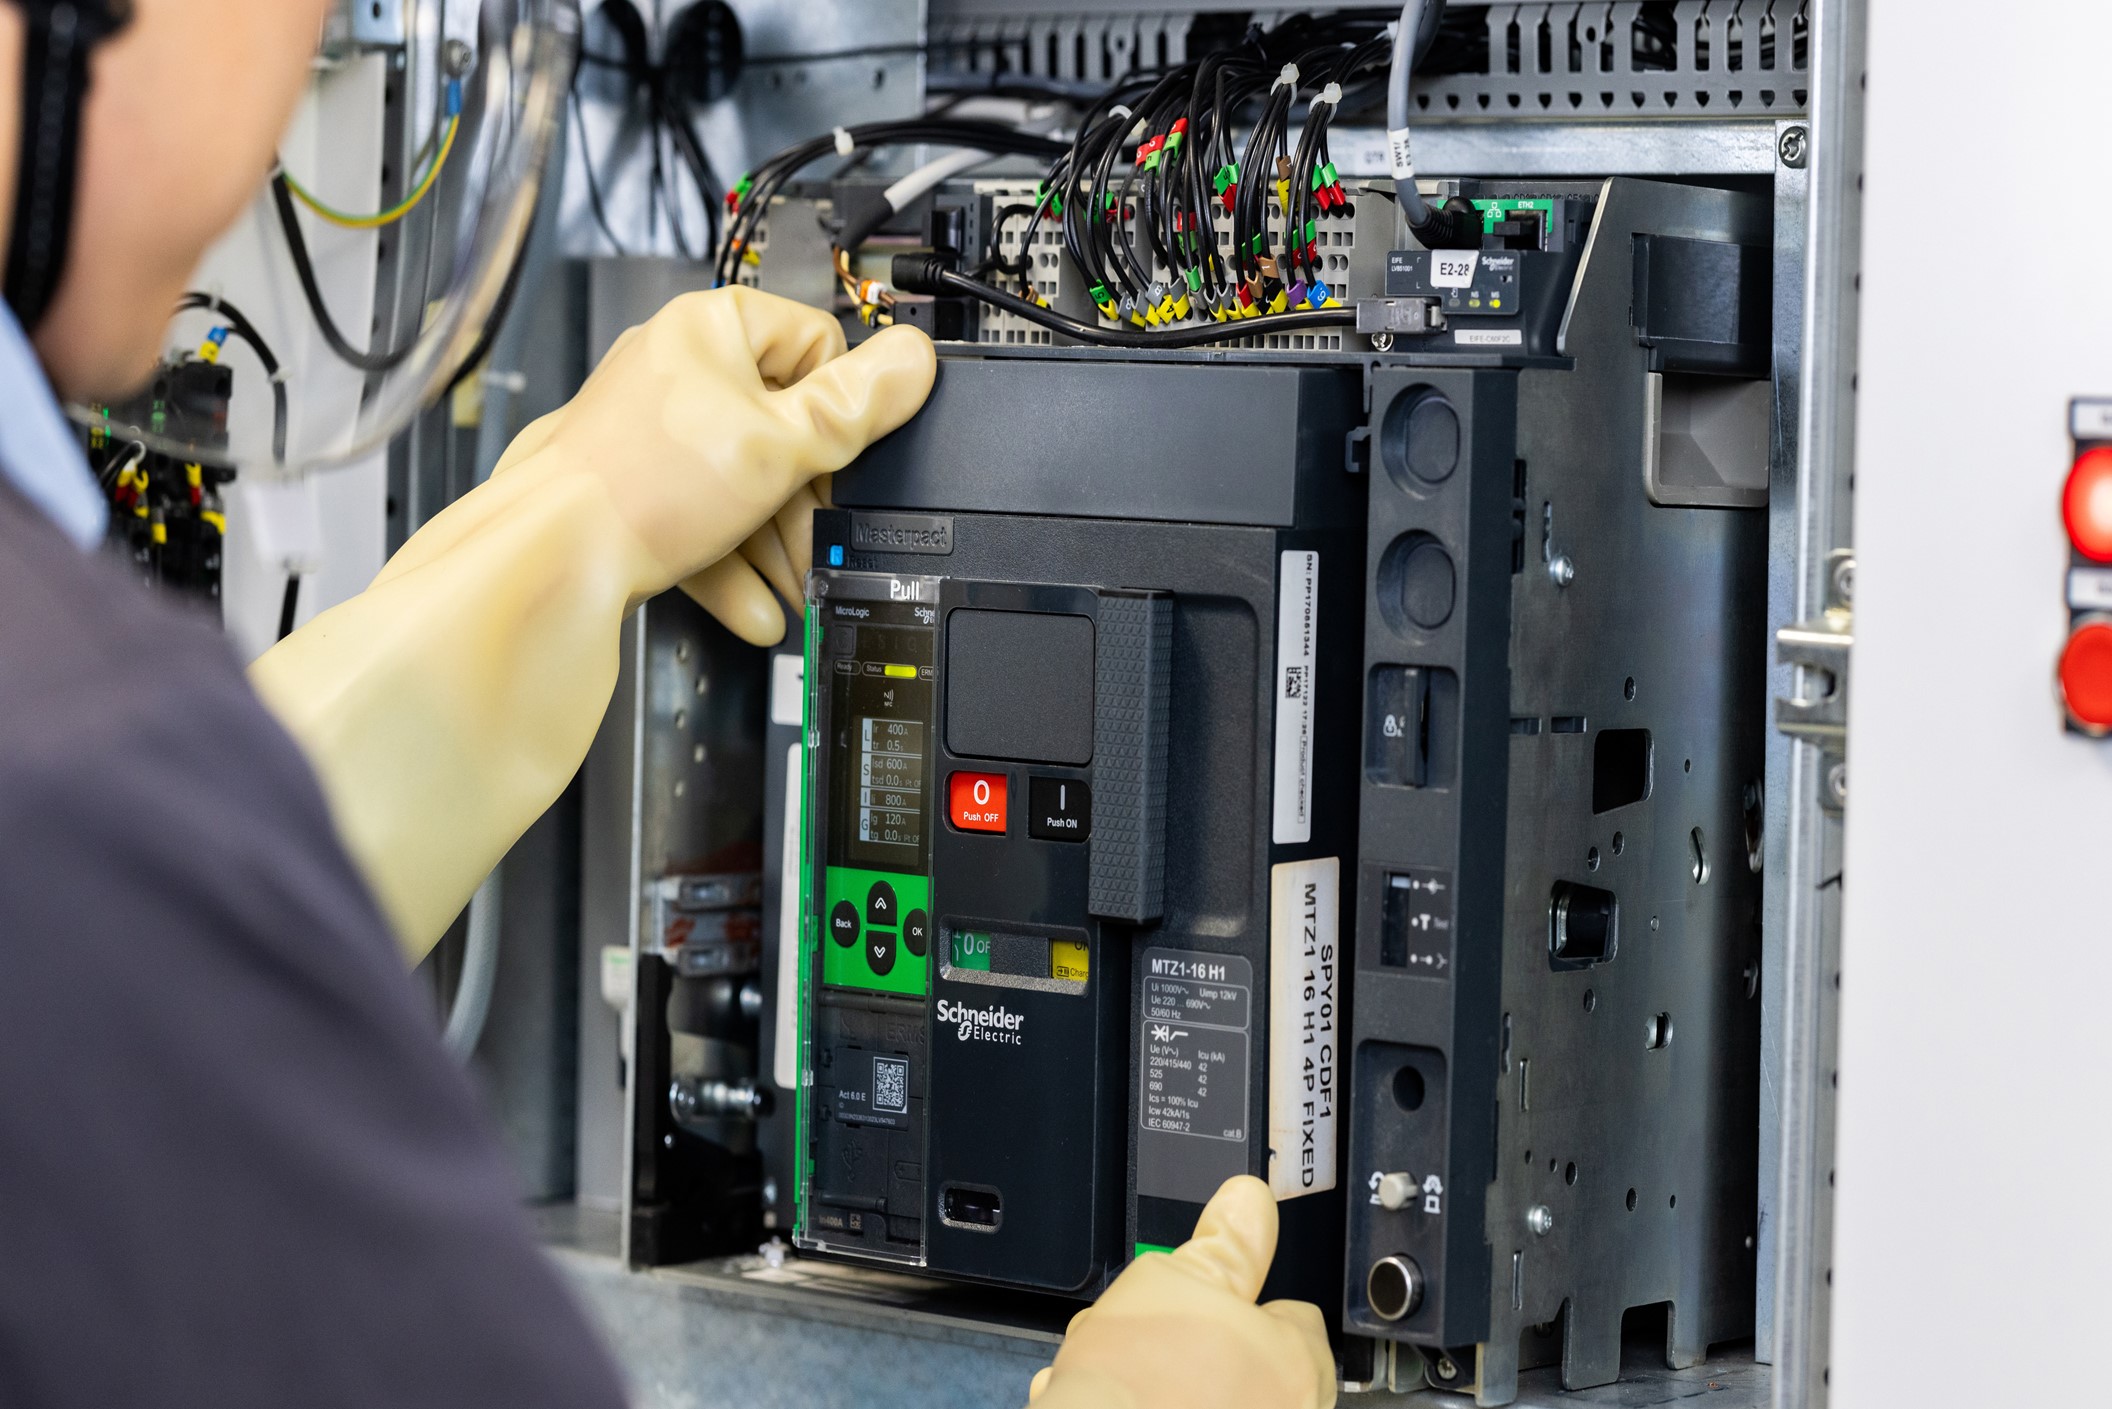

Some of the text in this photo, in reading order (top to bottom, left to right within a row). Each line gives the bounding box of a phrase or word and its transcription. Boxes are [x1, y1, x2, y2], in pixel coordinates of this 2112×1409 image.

[1481, 256, 1514, 265] Schneider
[1440, 263, 1470, 276] E2-28
[855, 523, 948, 550] Masterpact
[890, 580, 920, 600] Pull
[835, 606, 870, 618] MicroLogic
[866, 664, 882, 673] Status
[864, 729, 871, 742] L
[863, 763, 870, 776] S
[963, 811, 999, 822] Push OFF
[1046, 817, 1078, 829] Push ON
[861, 818, 869, 831] G
[836, 918, 852, 928] Back
[912, 927, 923, 936] OK
[1152, 958, 1225, 981] MTZ1-16 H1
[1151, 995, 1161, 1005] Ue
[1162, 996, 1176, 1006] 220
[1200, 988, 1218, 1000] Uimp
[1220, 990, 1237, 1000] 12kV
[937, 999, 1025, 1031] Schneider
[1151, 1007, 1181, 1019] 50/60 Hz
[973, 1026, 1022, 1045] Electric
[1302, 883, 1317, 1188] MTZ1 16 H1 4P FIXED
[1319, 944, 1333, 1118] SPY01 CDF1
[1150, 1044, 1161, 1054] Ue
[1210, 1051, 1226, 1063] (kA)
[1149, 1056, 1208, 1073] 220/415/440 42
[1149, 1068, 1208, 1085] 525 42
[838, 1089, 867, 1101] Act 6.0 E
[1149, 1081, 1208, 1097] 690 42
[1168, 1095, 1187, 1106] 100%
[1162, 1107, 1190, 1119] 42kA/1s
[1148, 1117, 1191, 1132] IEC 60947-2
